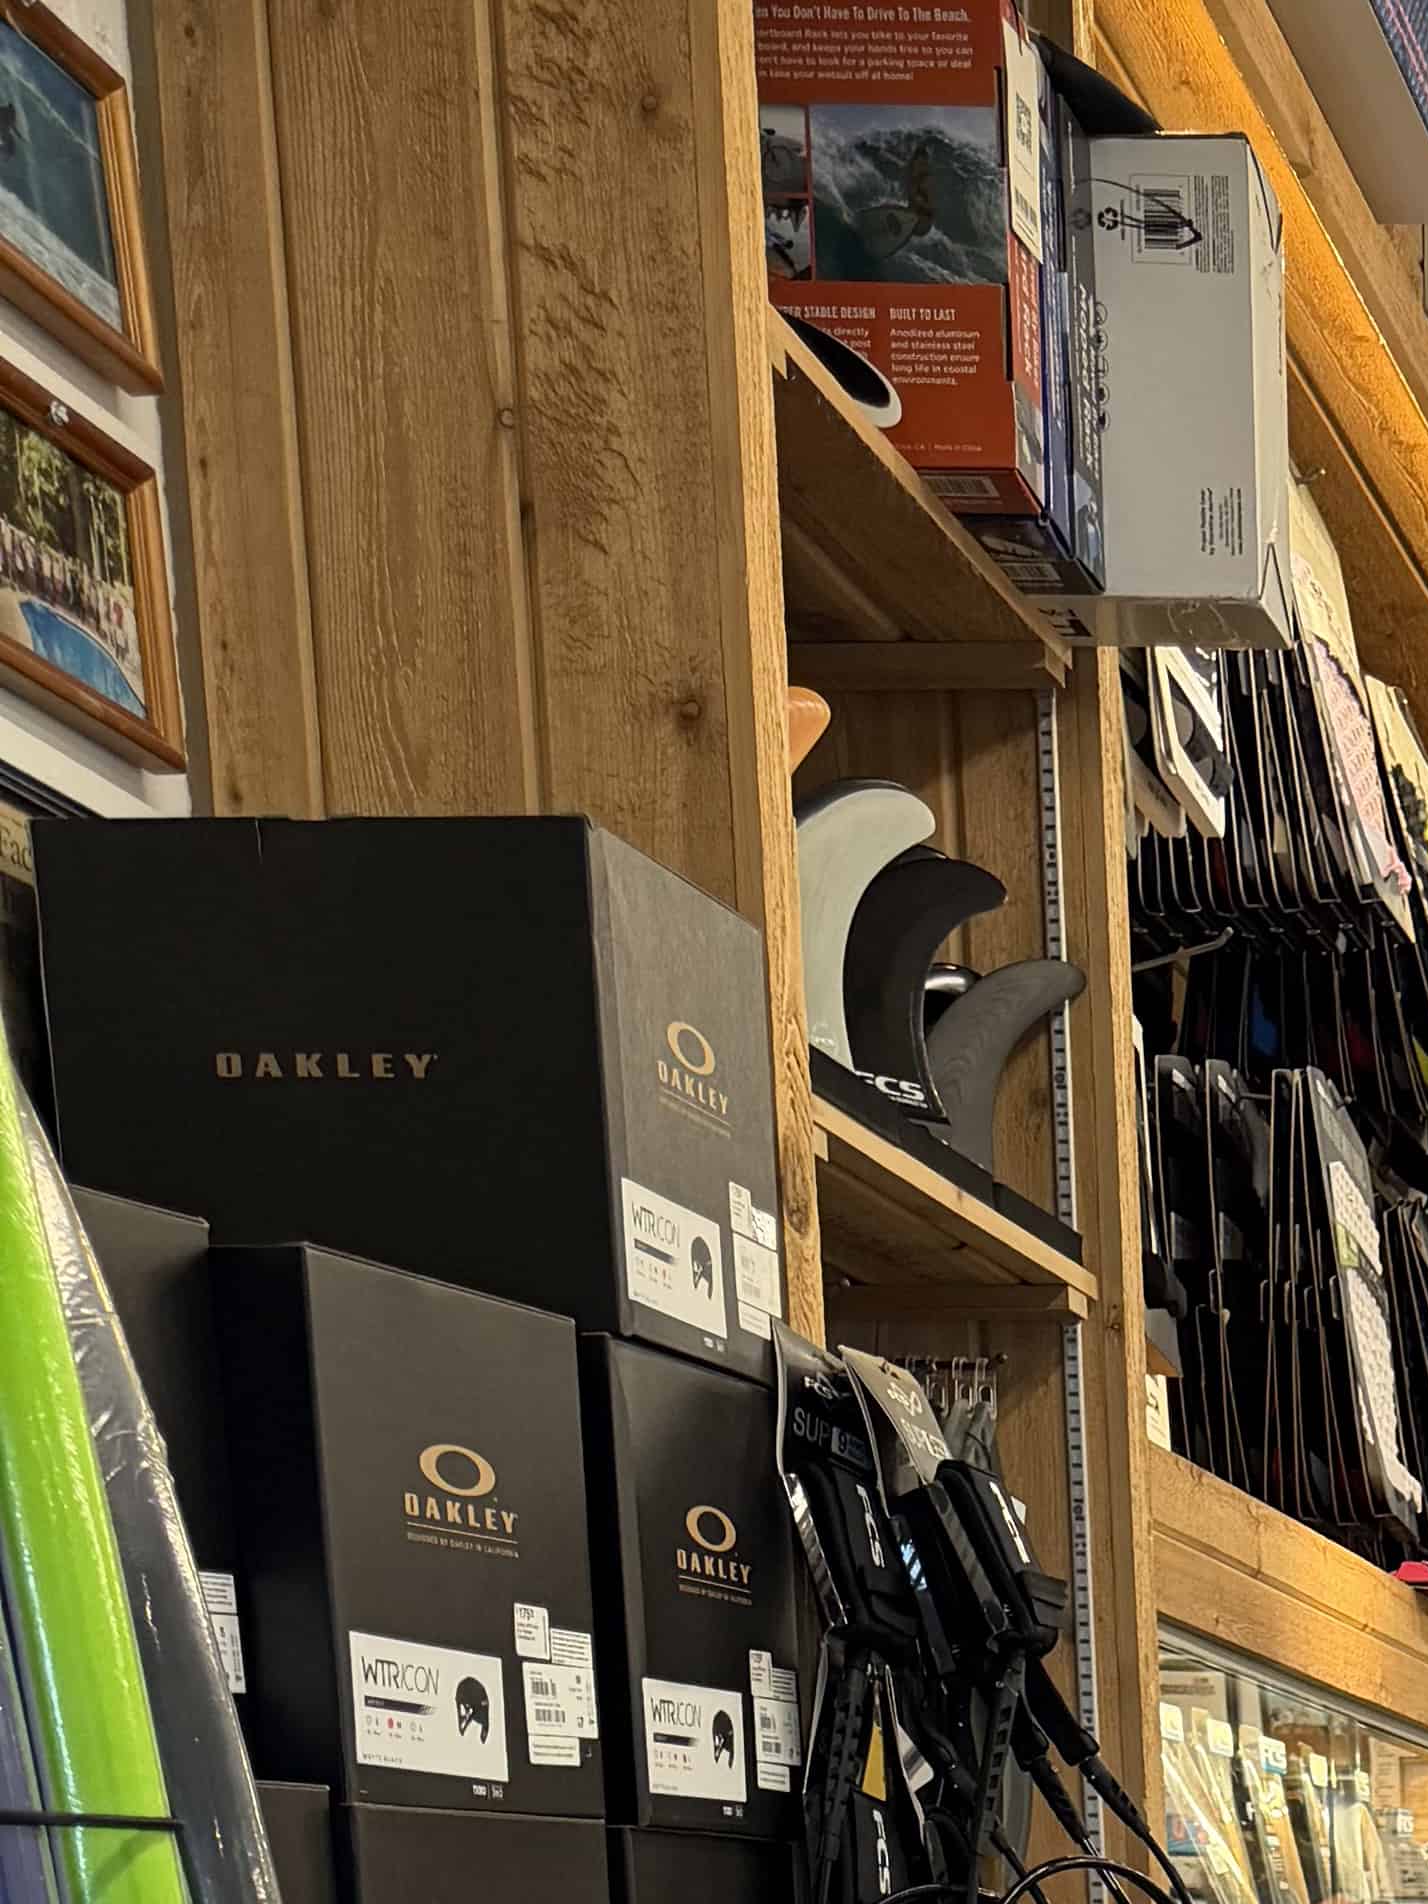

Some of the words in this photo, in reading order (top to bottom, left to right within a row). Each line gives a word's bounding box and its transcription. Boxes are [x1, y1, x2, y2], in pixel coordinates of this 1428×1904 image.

[772, 7, 790, 18] You
[793, 6, 821, 19] Don't
[824, 8, 849, 19] Have
[853, 7, 864, 20] To
[868, 8, 895, 20] Drive
[898, 8, 909, 21] To
[913, 8, 931, 22] The
[934, 8, 971, 22] Beach.
[803, 306, 838, 318] STABLE
[840, 307, 876, 319] DESIGN
[890, 308, 916, 320] BUILT
[920, 309, 930, 320] TO
[933, 309, 955, 320] LAST
[833, 328, 868, 338] directly
[216, 1051, 438, 1080] OAKLEY
[656, 1060, 730, 1117] OAKLEY
[403, 1491, 518, 1534] OAKLEY
[676, 1548, 752, 1585] OAKLEY
